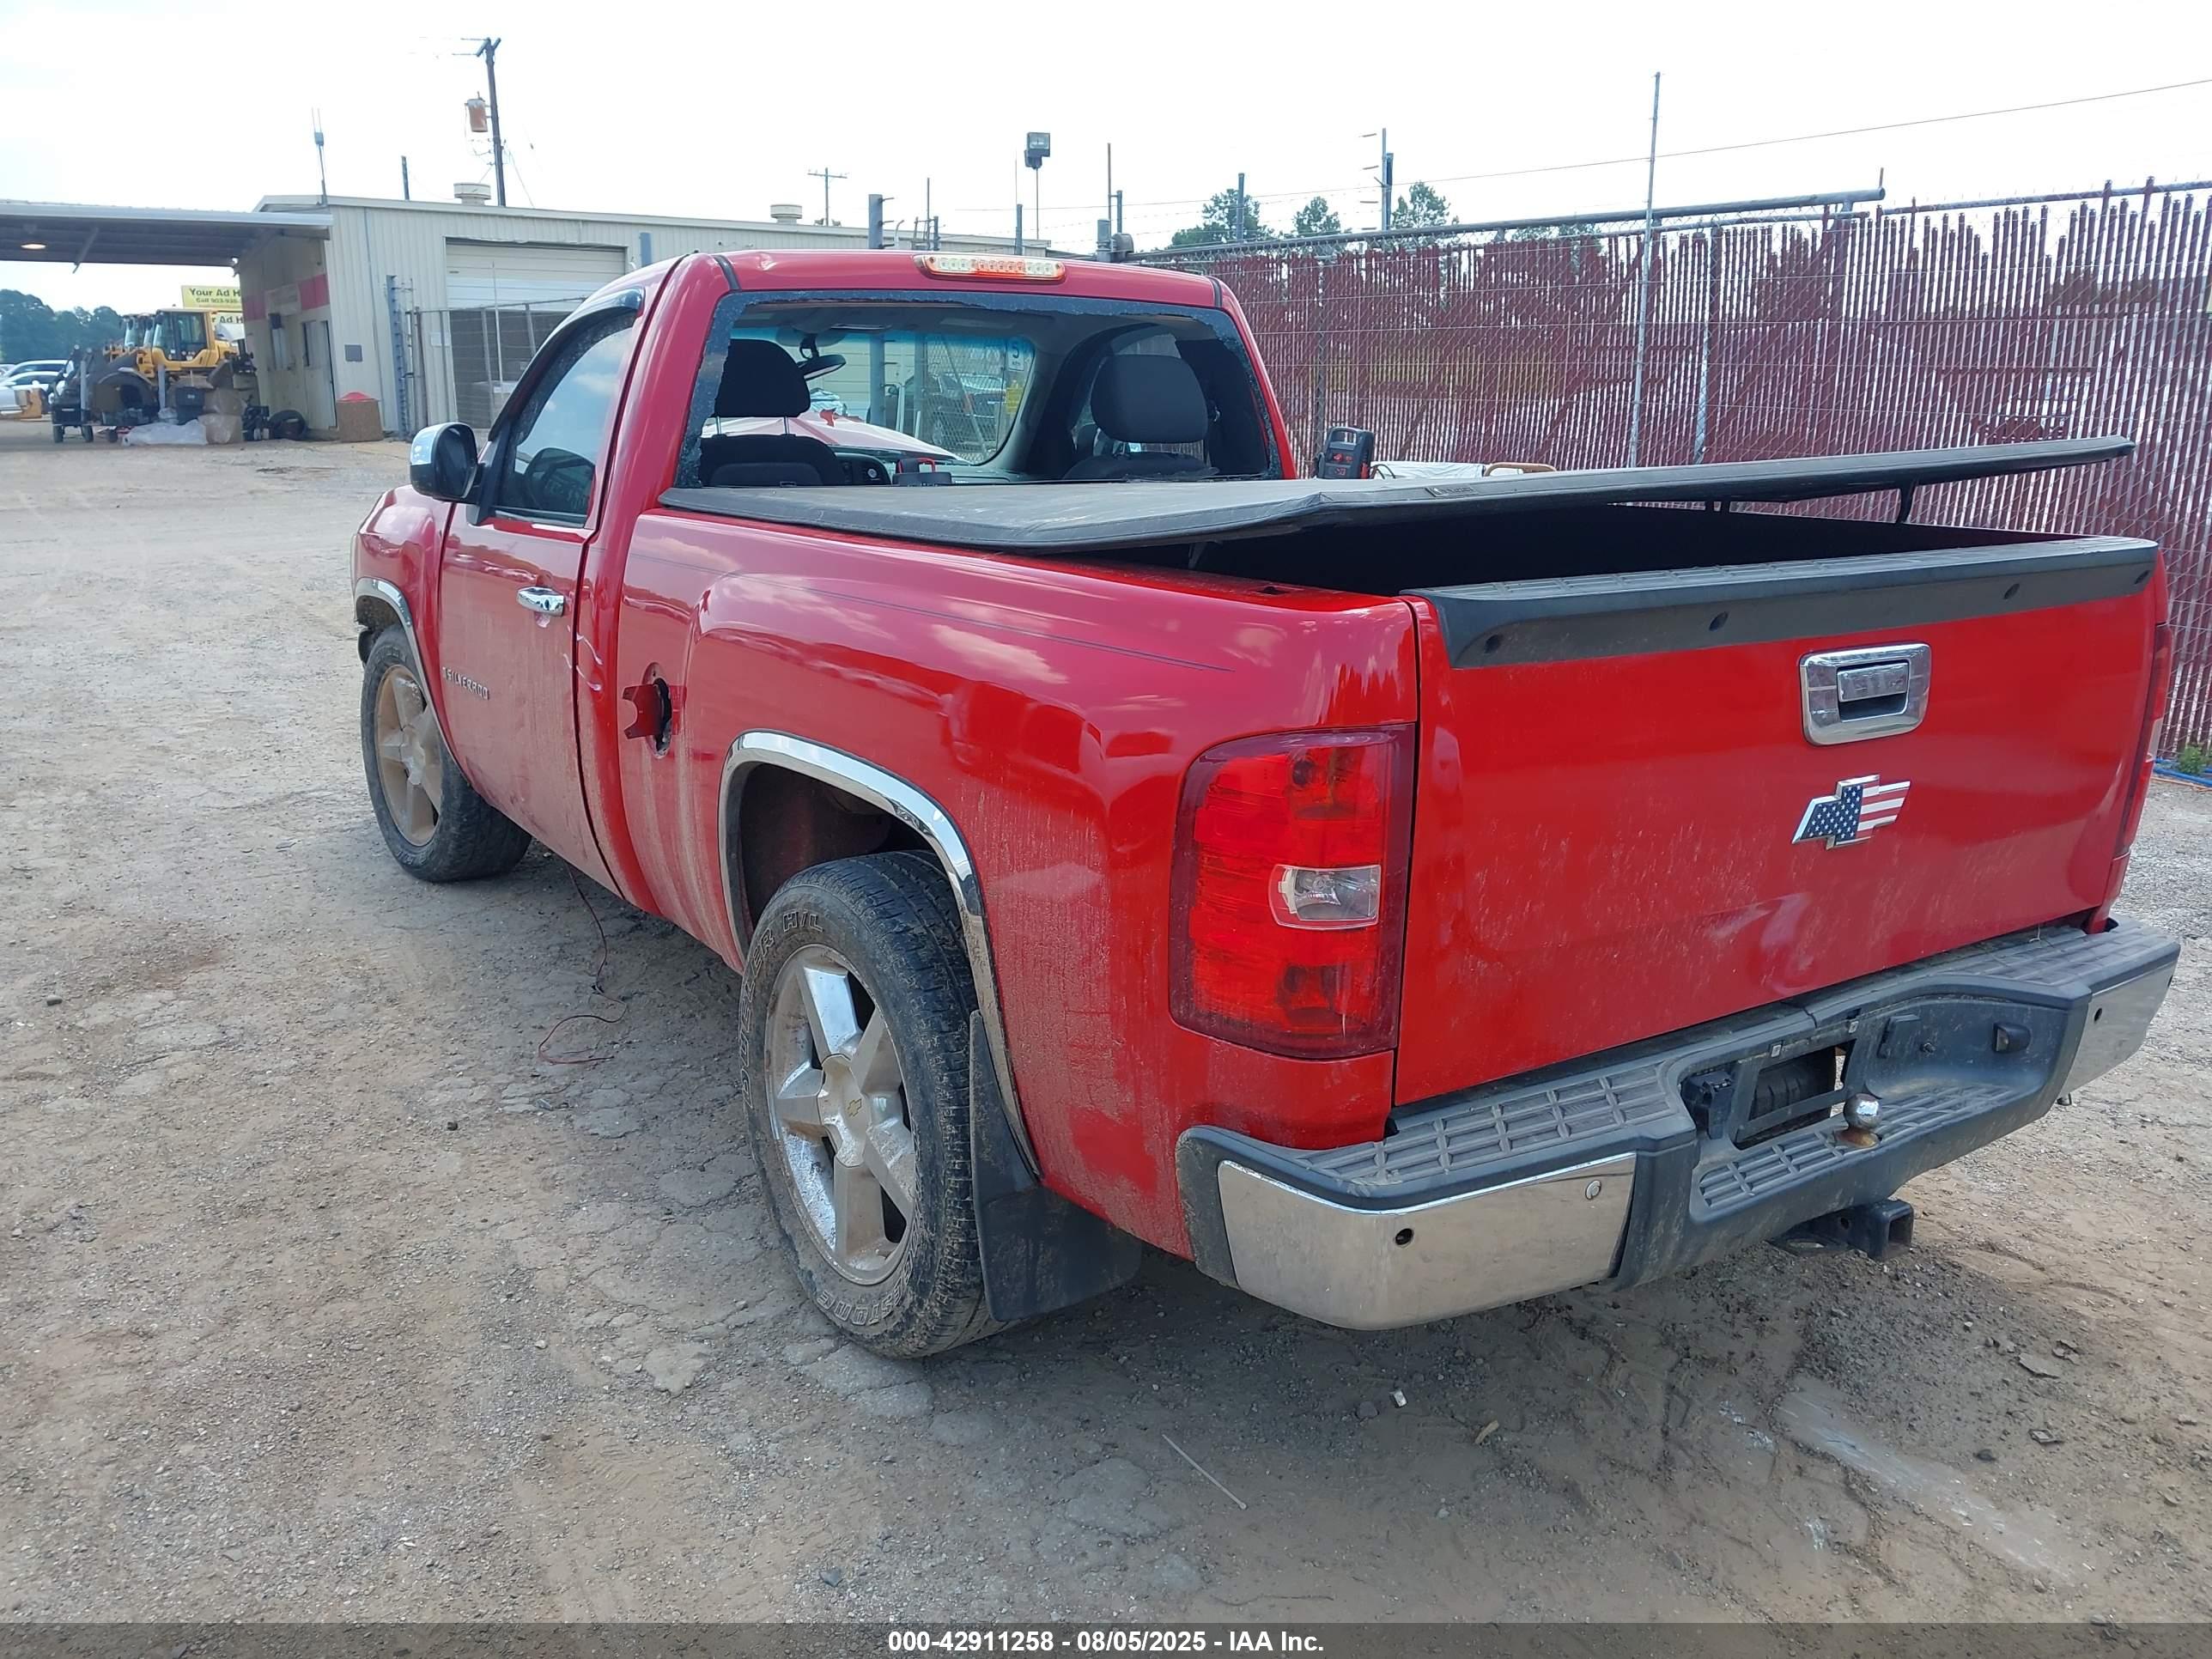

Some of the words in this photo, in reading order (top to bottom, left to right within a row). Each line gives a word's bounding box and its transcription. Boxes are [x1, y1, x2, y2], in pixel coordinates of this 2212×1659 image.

[189, 288, 213, 296] Your
[233, 289, 241, 297] H
[446, 668, 489, 701] SILVERADO
[739, 927, 775, 1109] DUELER
[782, 908, 824, 933] H/L
